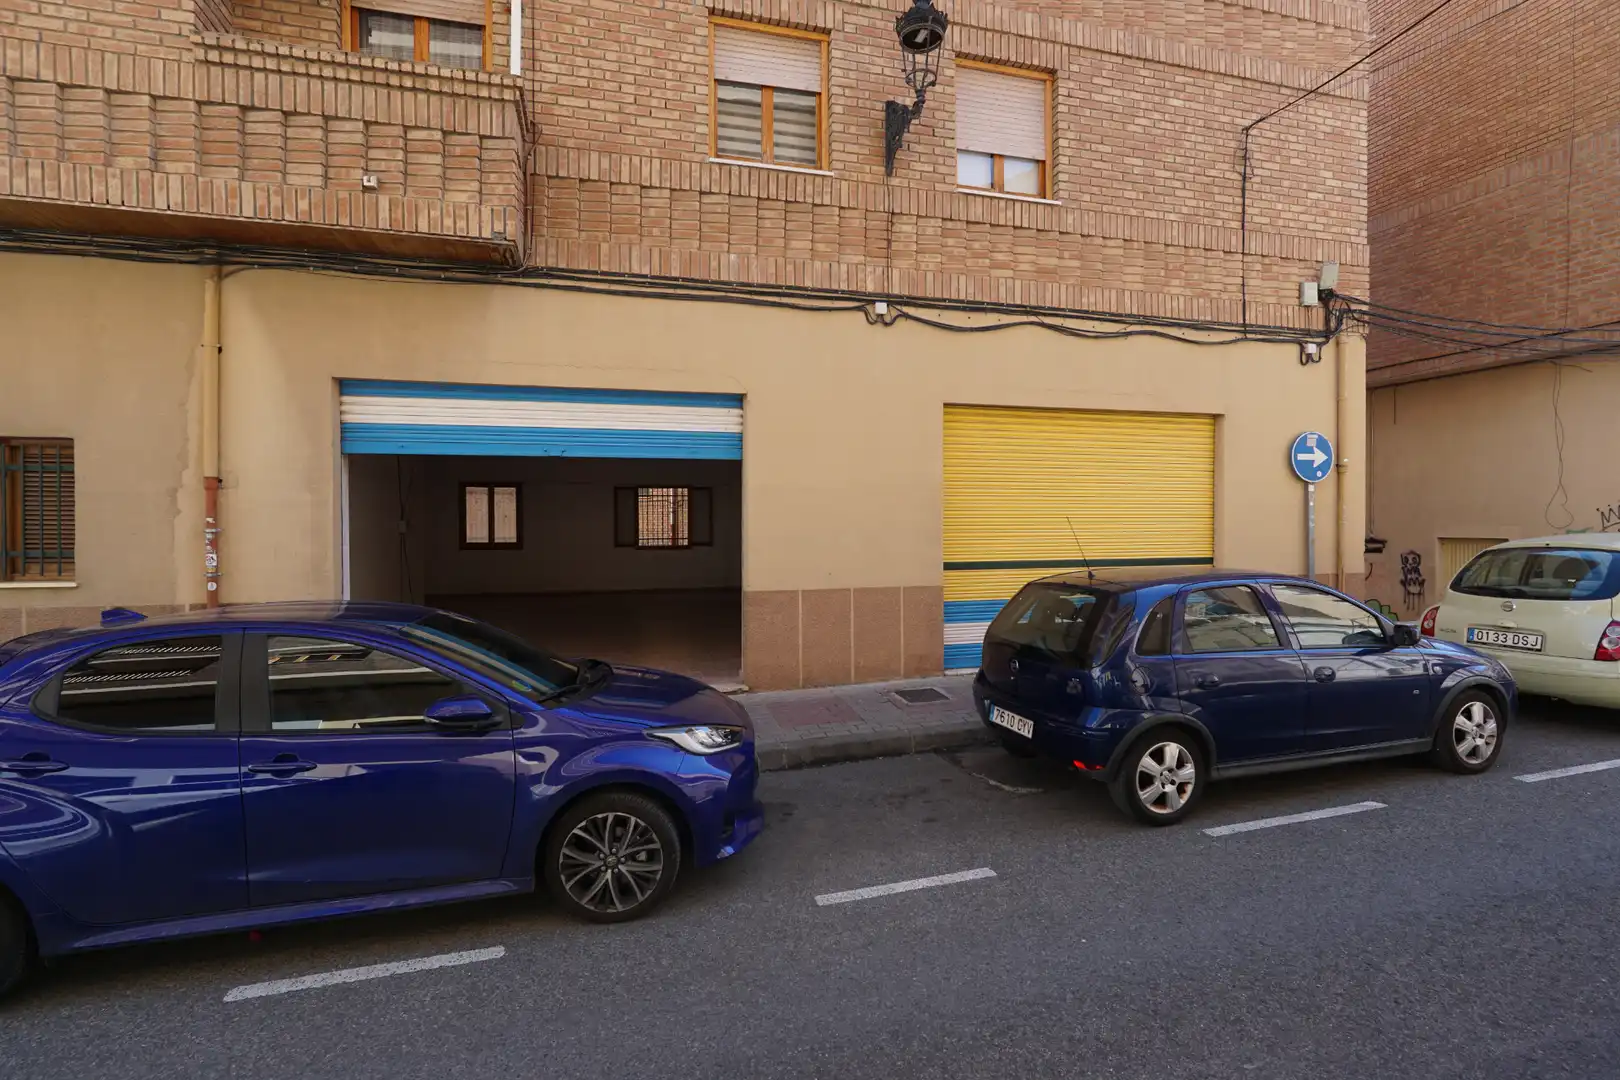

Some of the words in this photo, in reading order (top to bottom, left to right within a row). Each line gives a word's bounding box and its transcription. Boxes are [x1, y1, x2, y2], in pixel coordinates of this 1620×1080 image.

[1476, 630, 1508, 644] 0133
[1512, 634, 1539, 647] DSJ
[995, 708, 1015, 728] 7610
